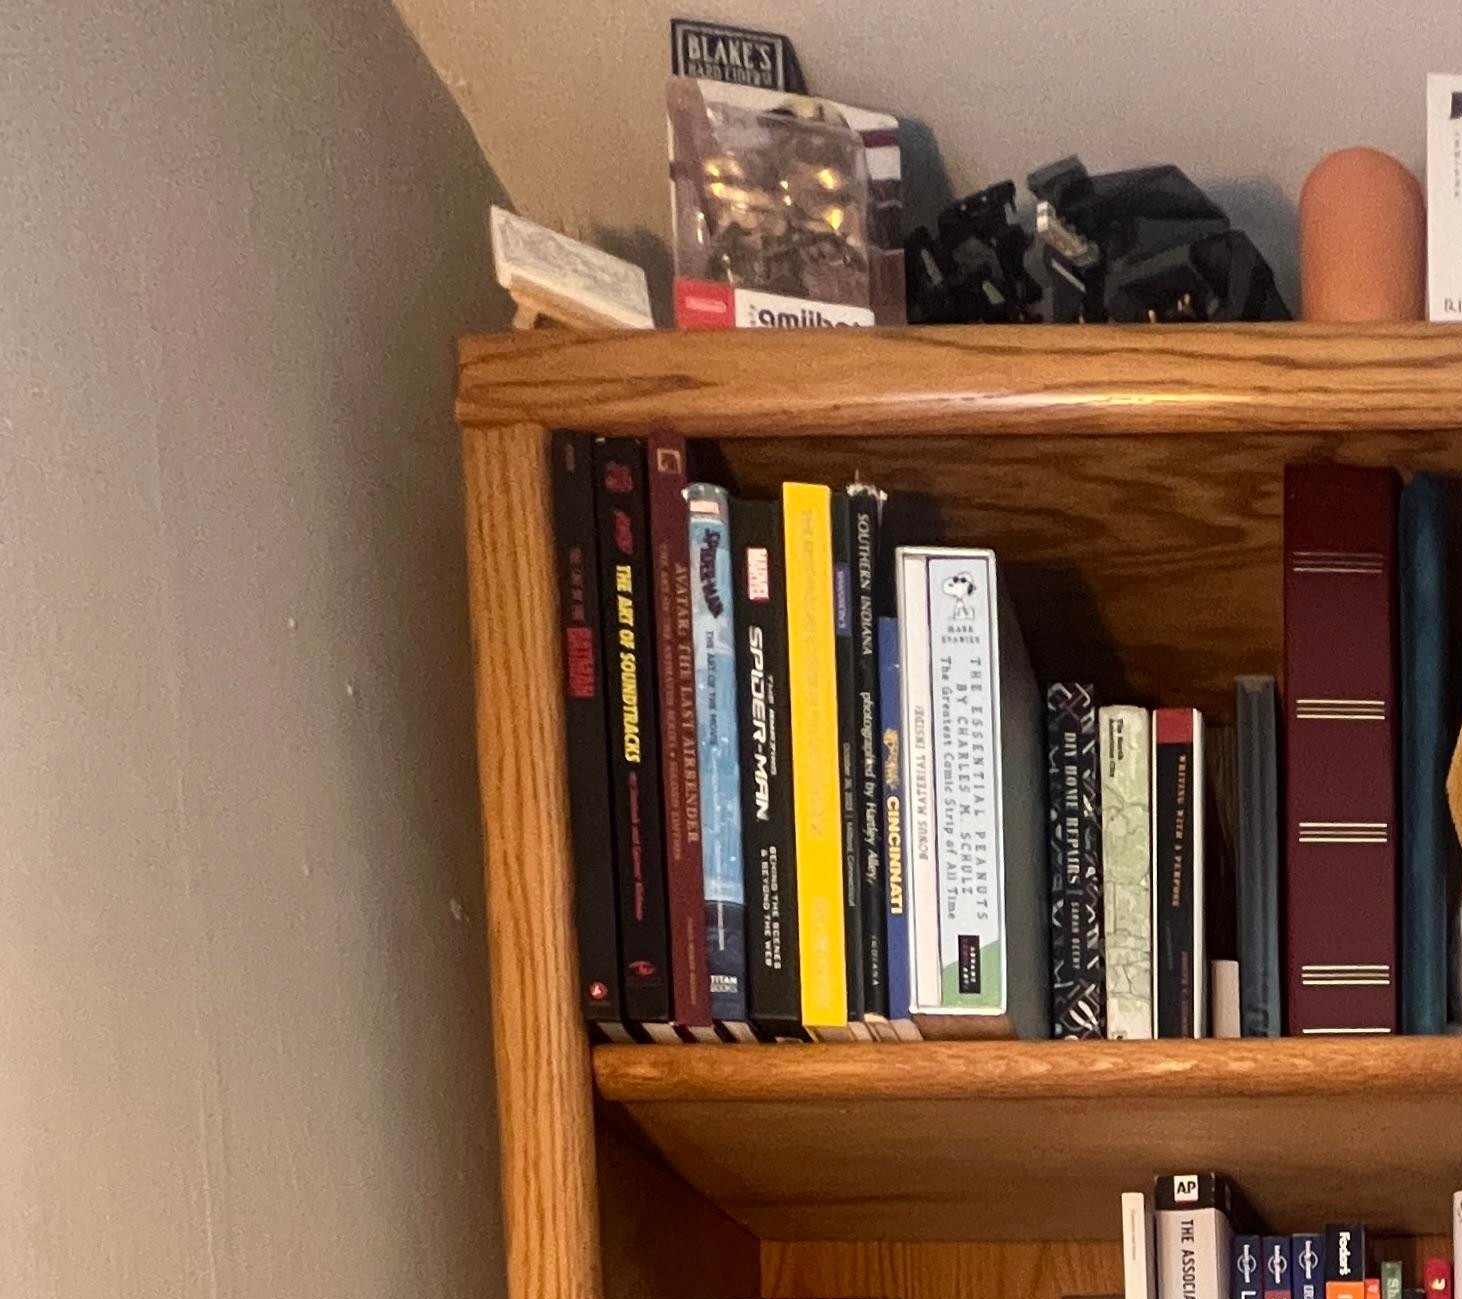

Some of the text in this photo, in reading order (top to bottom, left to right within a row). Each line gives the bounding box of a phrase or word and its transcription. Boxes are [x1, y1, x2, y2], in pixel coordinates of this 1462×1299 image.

[687, 33, 772, 70] BLAKE'S
[746, 547, 770, 601] MARVEL
[857, 512, 873, 656] SOUTHERN INDIANA
[615, 564, 643, 763] THE ART OF SOUNDTRACKS
[956, 682, 968, 704] BY
[747, 625, 770, 822] SPIDER-MAN
[956, 715, 970, 796] CHARLES
[940, 656, 959, 920] The Greatest Comic Strip of All Time
[970, 656, 988, 920] THE ESSENTIAL PEANUTS
[1063, 731, 1082, 885] DIY HOME REPAIRS
[886, 795, 904, 915] CINCINNATI
[960, 831, 973, 896] SCHULZ
[1176, 1181, 1196, 1195] AP
[1180, 1218, 1194, 1244] THE
[1338, 1231, 1351, 1276] Fodor's
